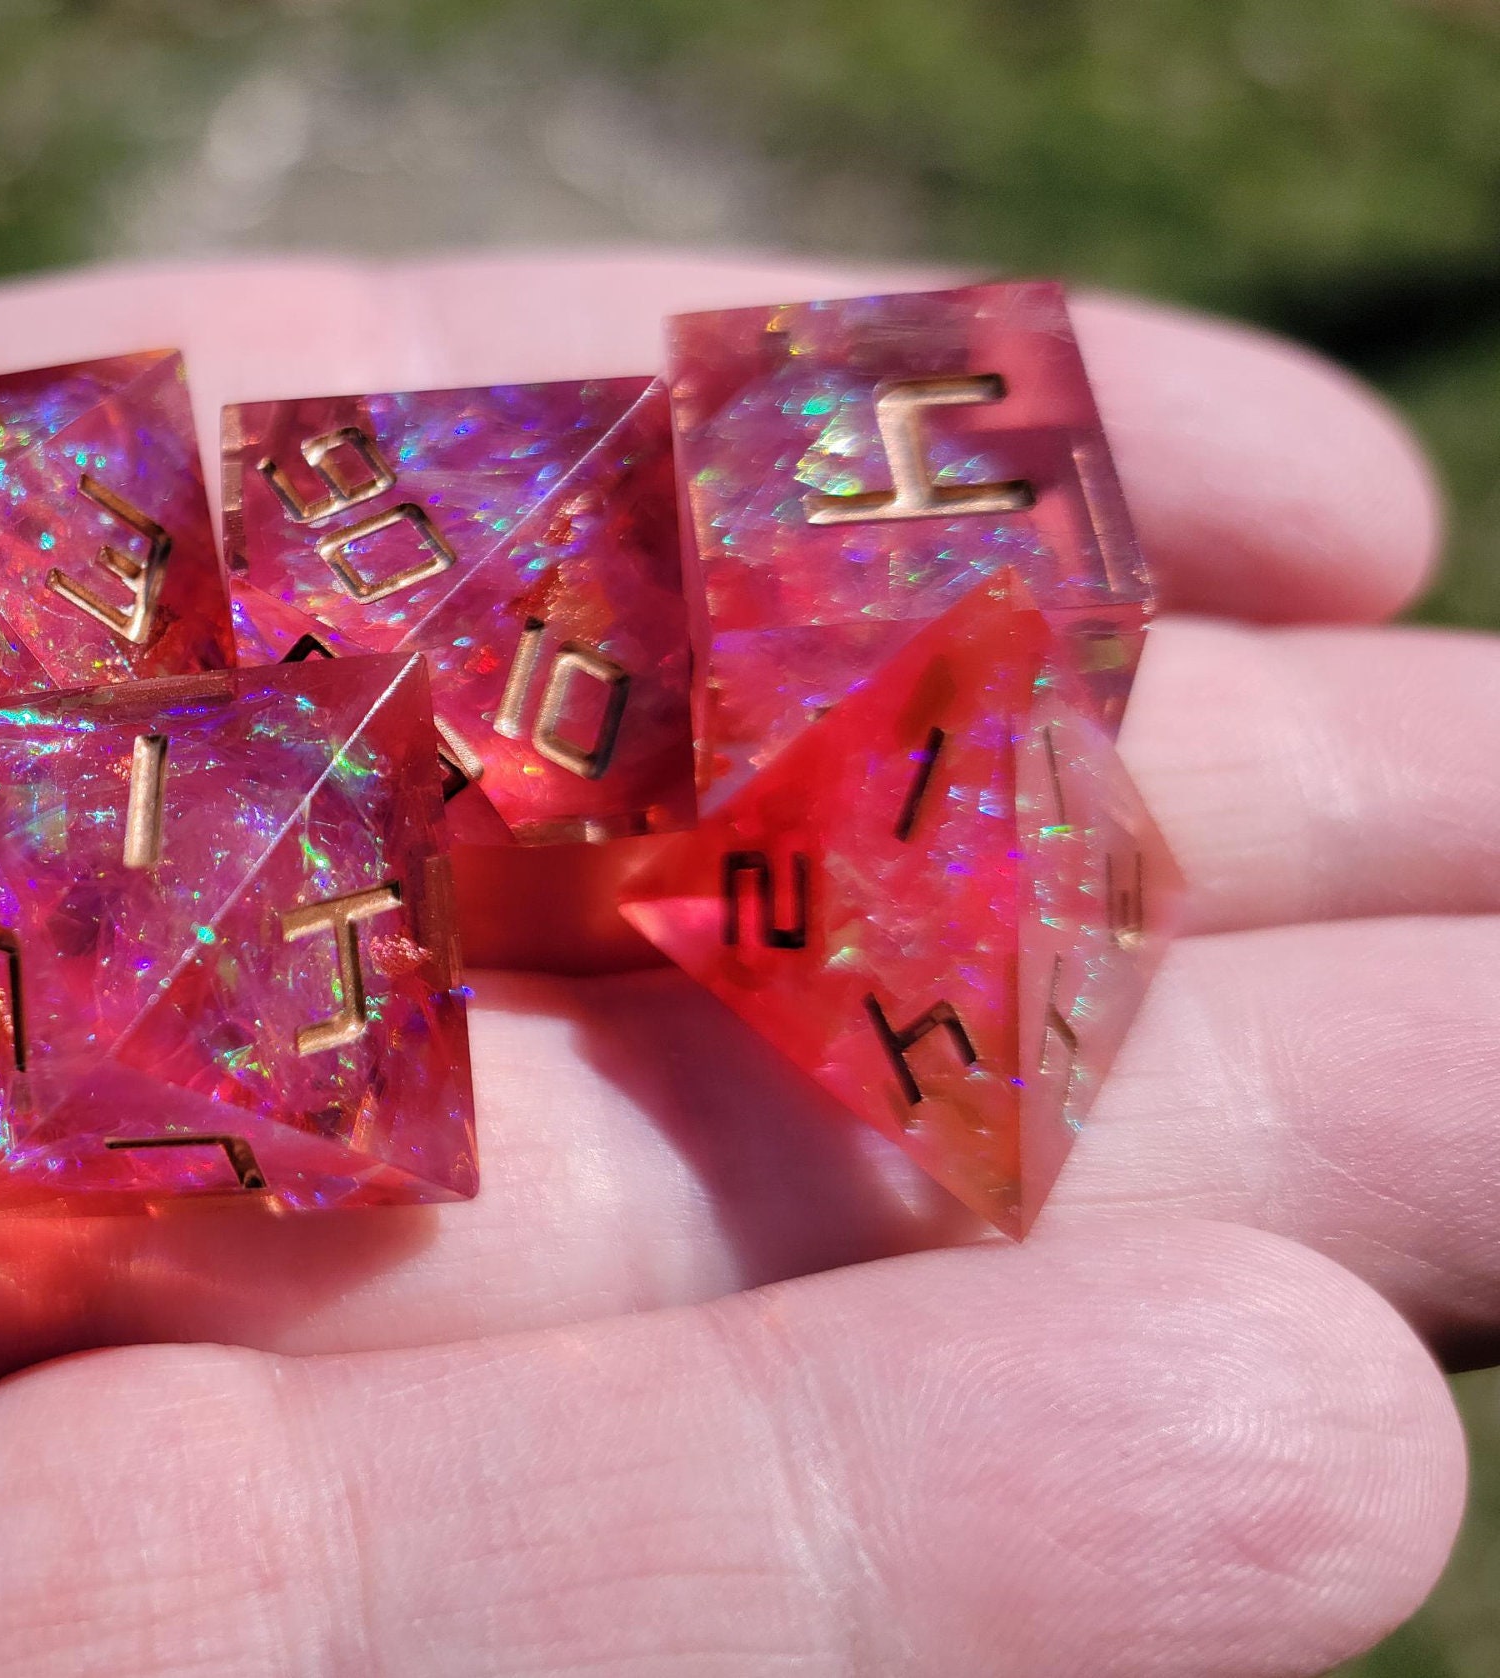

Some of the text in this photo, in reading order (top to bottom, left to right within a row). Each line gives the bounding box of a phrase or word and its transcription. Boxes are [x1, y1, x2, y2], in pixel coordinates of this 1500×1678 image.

[492, 614, 631, 781] 10
[121, 733, 169, 868] 1
[893, 726, 946, 843] 1
